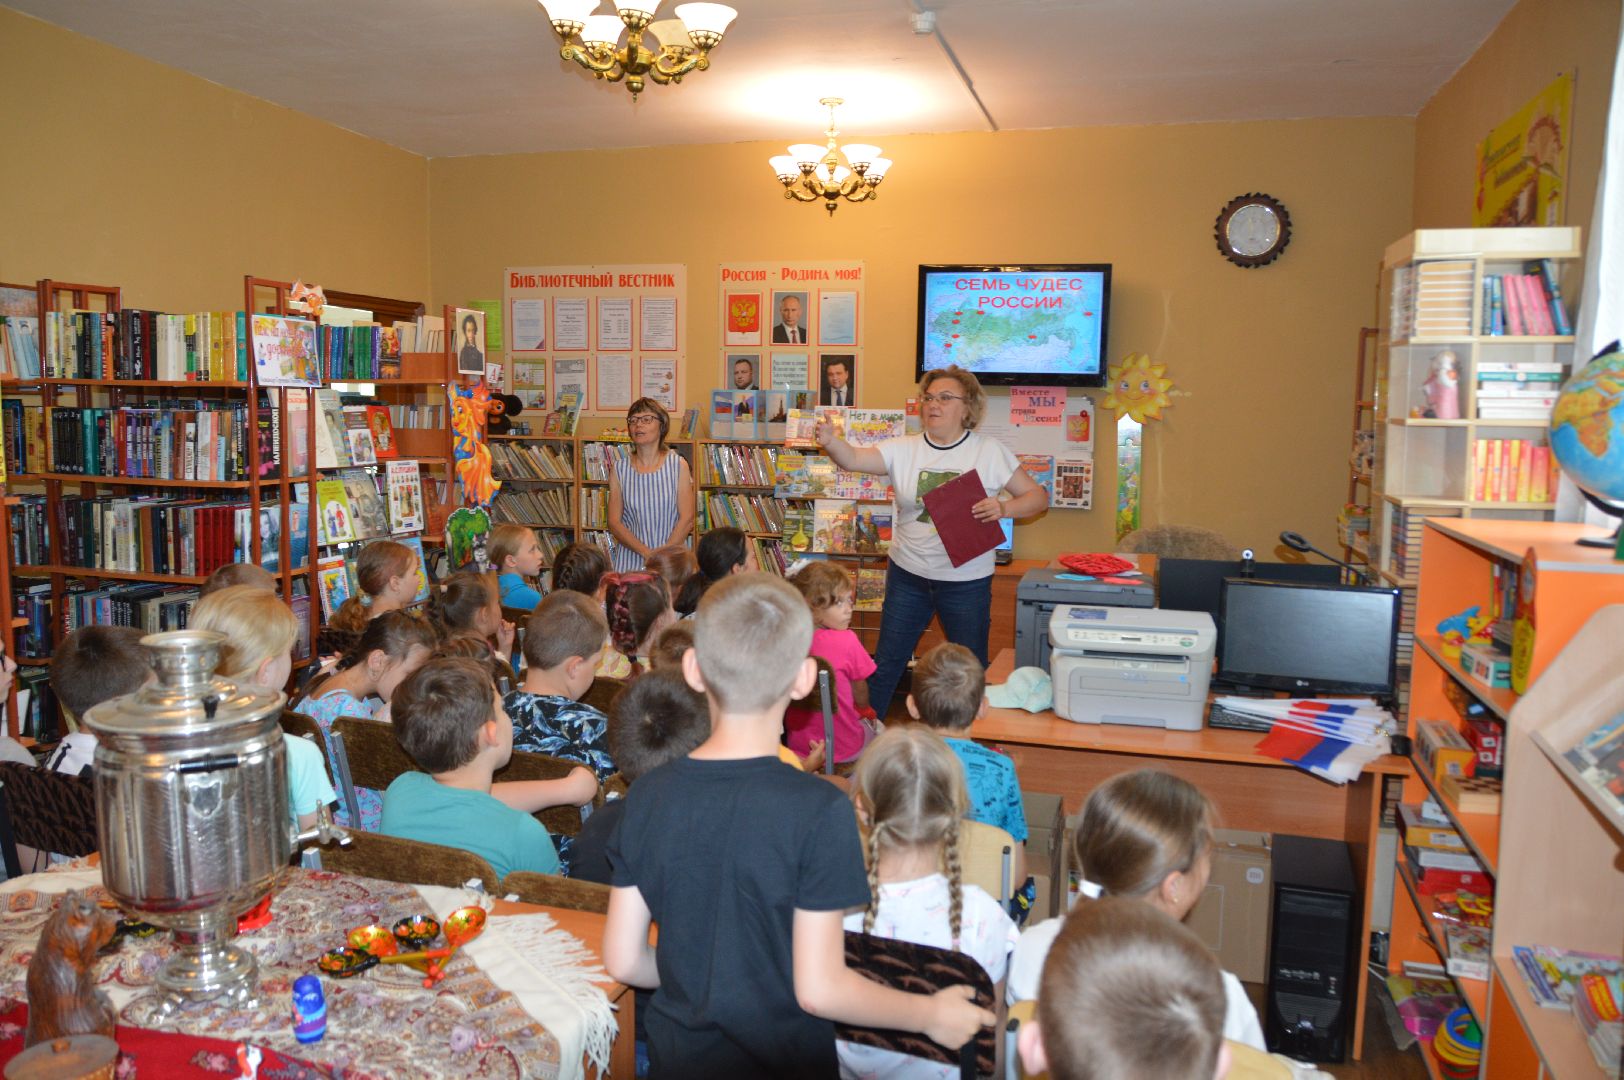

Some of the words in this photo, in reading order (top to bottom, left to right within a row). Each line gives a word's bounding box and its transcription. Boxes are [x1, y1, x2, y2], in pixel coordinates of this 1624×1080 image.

[955, 278, 1011, 291] СЕМЬ
[1016, 278, 1083, 293] ЧУДЕС
[978, 296, 1063, 309] РОССИИ
[1011, 388, 1050, 396] Вместе
[1028, 396, 1056, 408] МЫ
[849, 409, 867, 421] Нет
